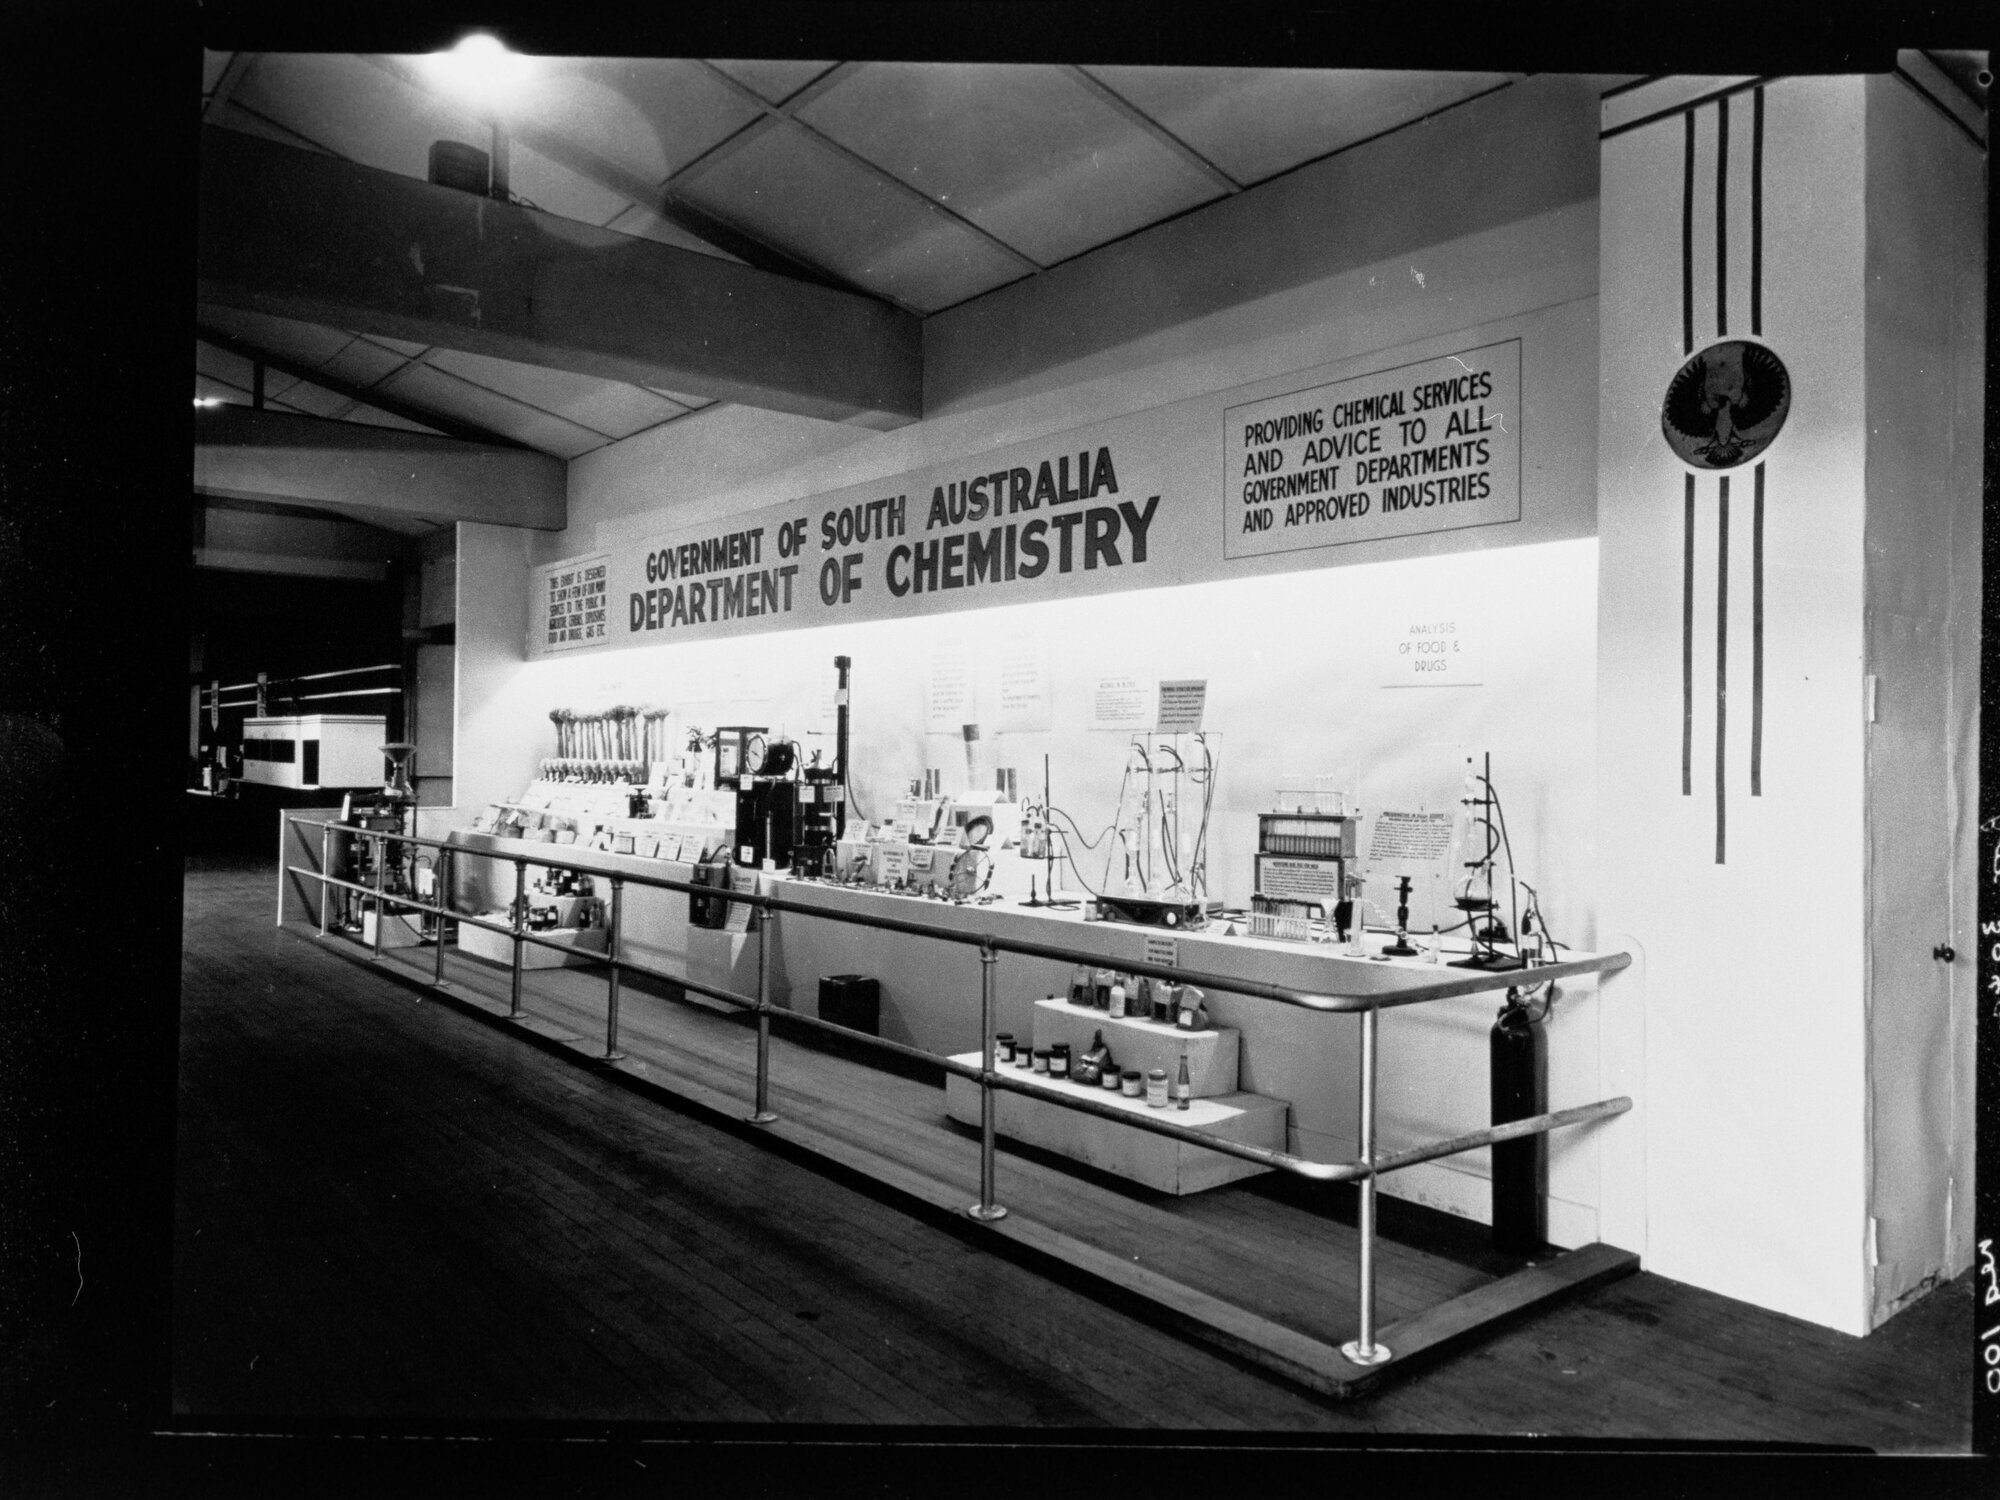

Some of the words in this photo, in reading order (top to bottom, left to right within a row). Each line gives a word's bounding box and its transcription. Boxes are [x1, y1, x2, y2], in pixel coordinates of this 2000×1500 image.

[1244, 449, 1283, 477] AND
[1302, 427, 1381, 466] ADVICE
[1400, 418, 1426, 446] TO
[1446, 406, 1492, 438] ALL
[1245, 408, 1324, 447] PROVIDING
[1333, 391, 1406, 428] CHEMICAL
[1413, 371, 1492, 412] SERVICES
[1242, 508, 1272, 534] AND
[1285, 492, 1370, 527] APPROVED
[1383, 472, 1490, 513] INDUSTRIES
[1244, 466, 1340, 505] GOVERNMENT
[1356, 438, 1490, 486] DEPARTMENTS
[645, 527, 764, 583] GOVERNMENT
[778, 518, 808, 558] OF
[821, 494, 906, 549] SOUTH
[928, 446, 1118, 529] AUSTRALIA
[630, 565, 798, 631] DEPARTMENT
[819, 554, 862, 606] OF
[886, 496, 1160, 597] CHEMISTRY
[1399, 642, 1412, 654] OF
[1417, 641, 1446, 654] FOOD
[1453, 640, 1460, 652] &
[1410, 622, 1456, 635] ANALYSIS
[1414, 660, 1447, 672] DRUGS
